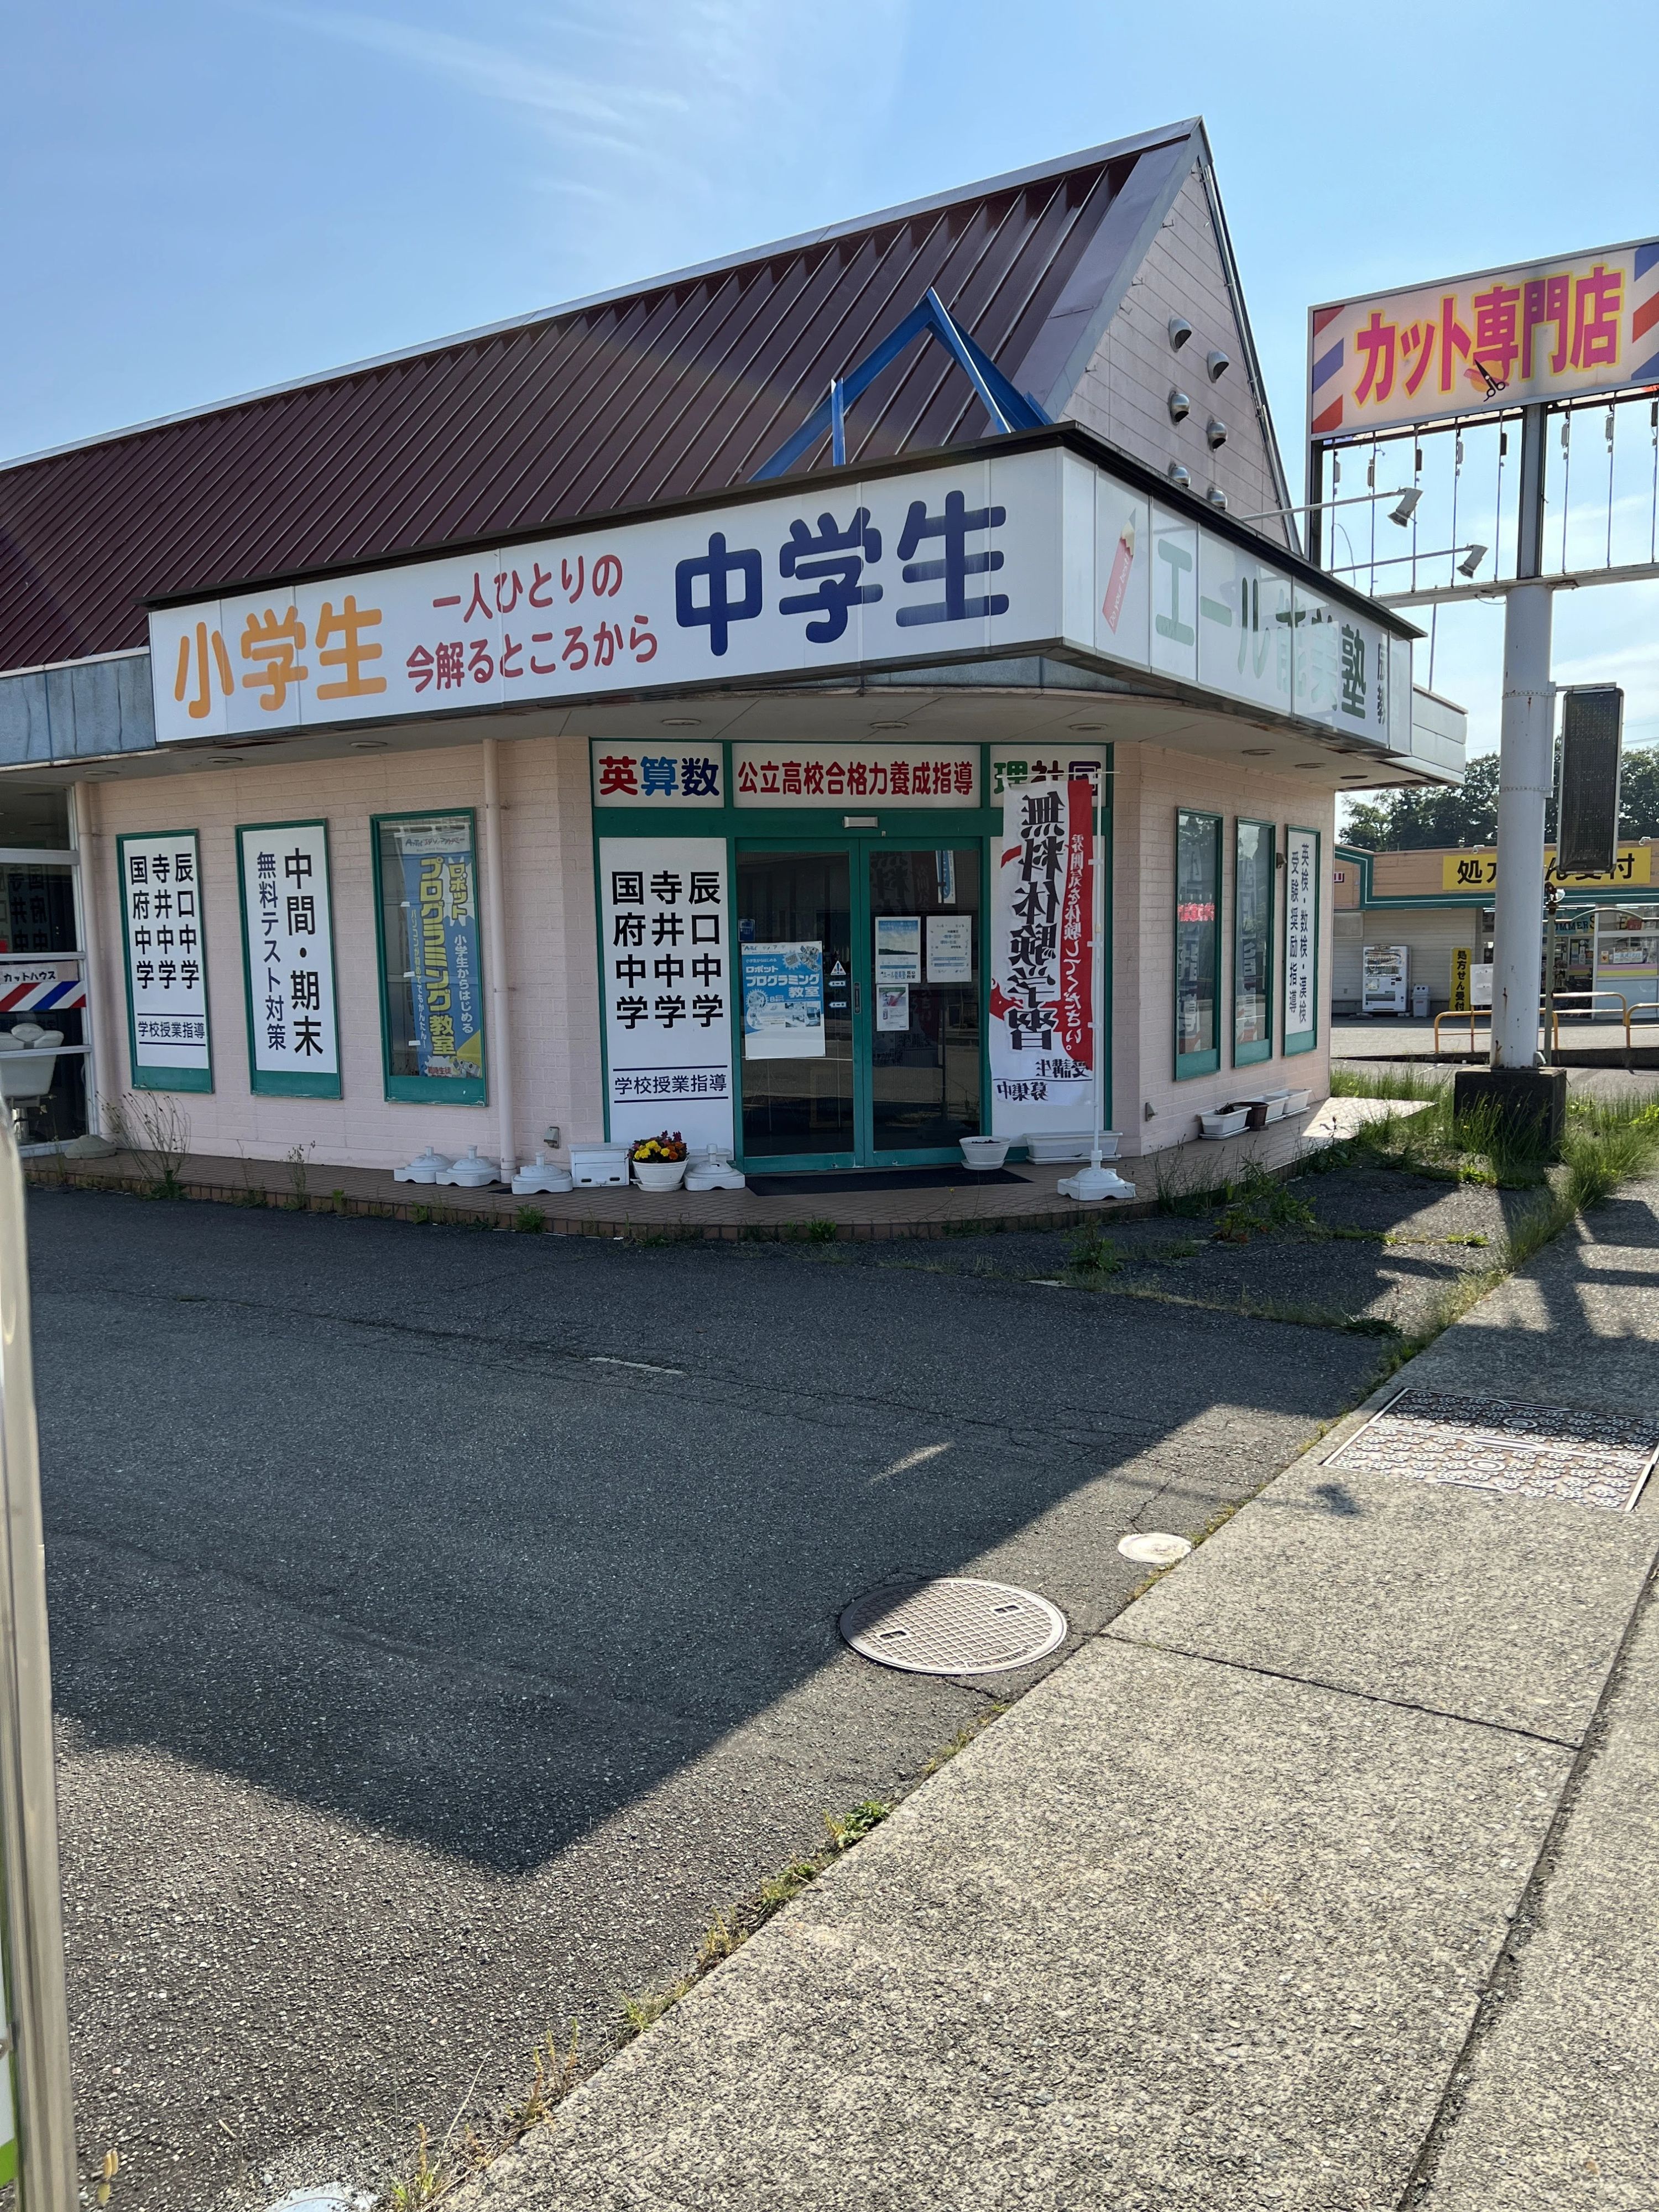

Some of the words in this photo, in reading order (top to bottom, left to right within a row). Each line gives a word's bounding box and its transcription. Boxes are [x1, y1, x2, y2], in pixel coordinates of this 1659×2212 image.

[1354, 265, 1623, 405] カット専門店
[432, 555, 623, 623] 一人ひとりの
[675, 490, 1009, 656] 中学生
[174, 594, 387, 719] 小学生
[406, 615, 658, 693] 今解るところから
[1109, 611, 1117, 628] Do
[599, 755, 720, 796] 英算数
[738, 761, 973, 796] 公立高校合格力養成指導
[129, 855, 154, 989] 国府中学
[152, 854, 176, 989] 寺井中学
[175, 853, 200, 990] 辰口中学
[448, 863, 467, 920] ロボット
[4, 971, 56, 982] カットハウス
[257, 851, 286, 1051] 無料テスト対策
[284, 848, 324, 1057] 中間・期末
[420, 857, 457, 1056] プログラミング教室
[455, 935, 473, 1034] 小学生からはじめる
[612, 871, 648, 1030] 国府中学
[650, 870, 686, 1029] 寺井中学
[688, 871, 723, 1028] 辰口中学
[745, 965, 779, 973] ロボット
[745, 973, 820, 987] プログラミング
[789, 987, 820, 998] 教室
[1454, 950, 1467, 1011] 処方せん受付
[138, 1021, 205, 1039] 学校授業指導
[614, 1074, 727, 1095] 学校授業指導
